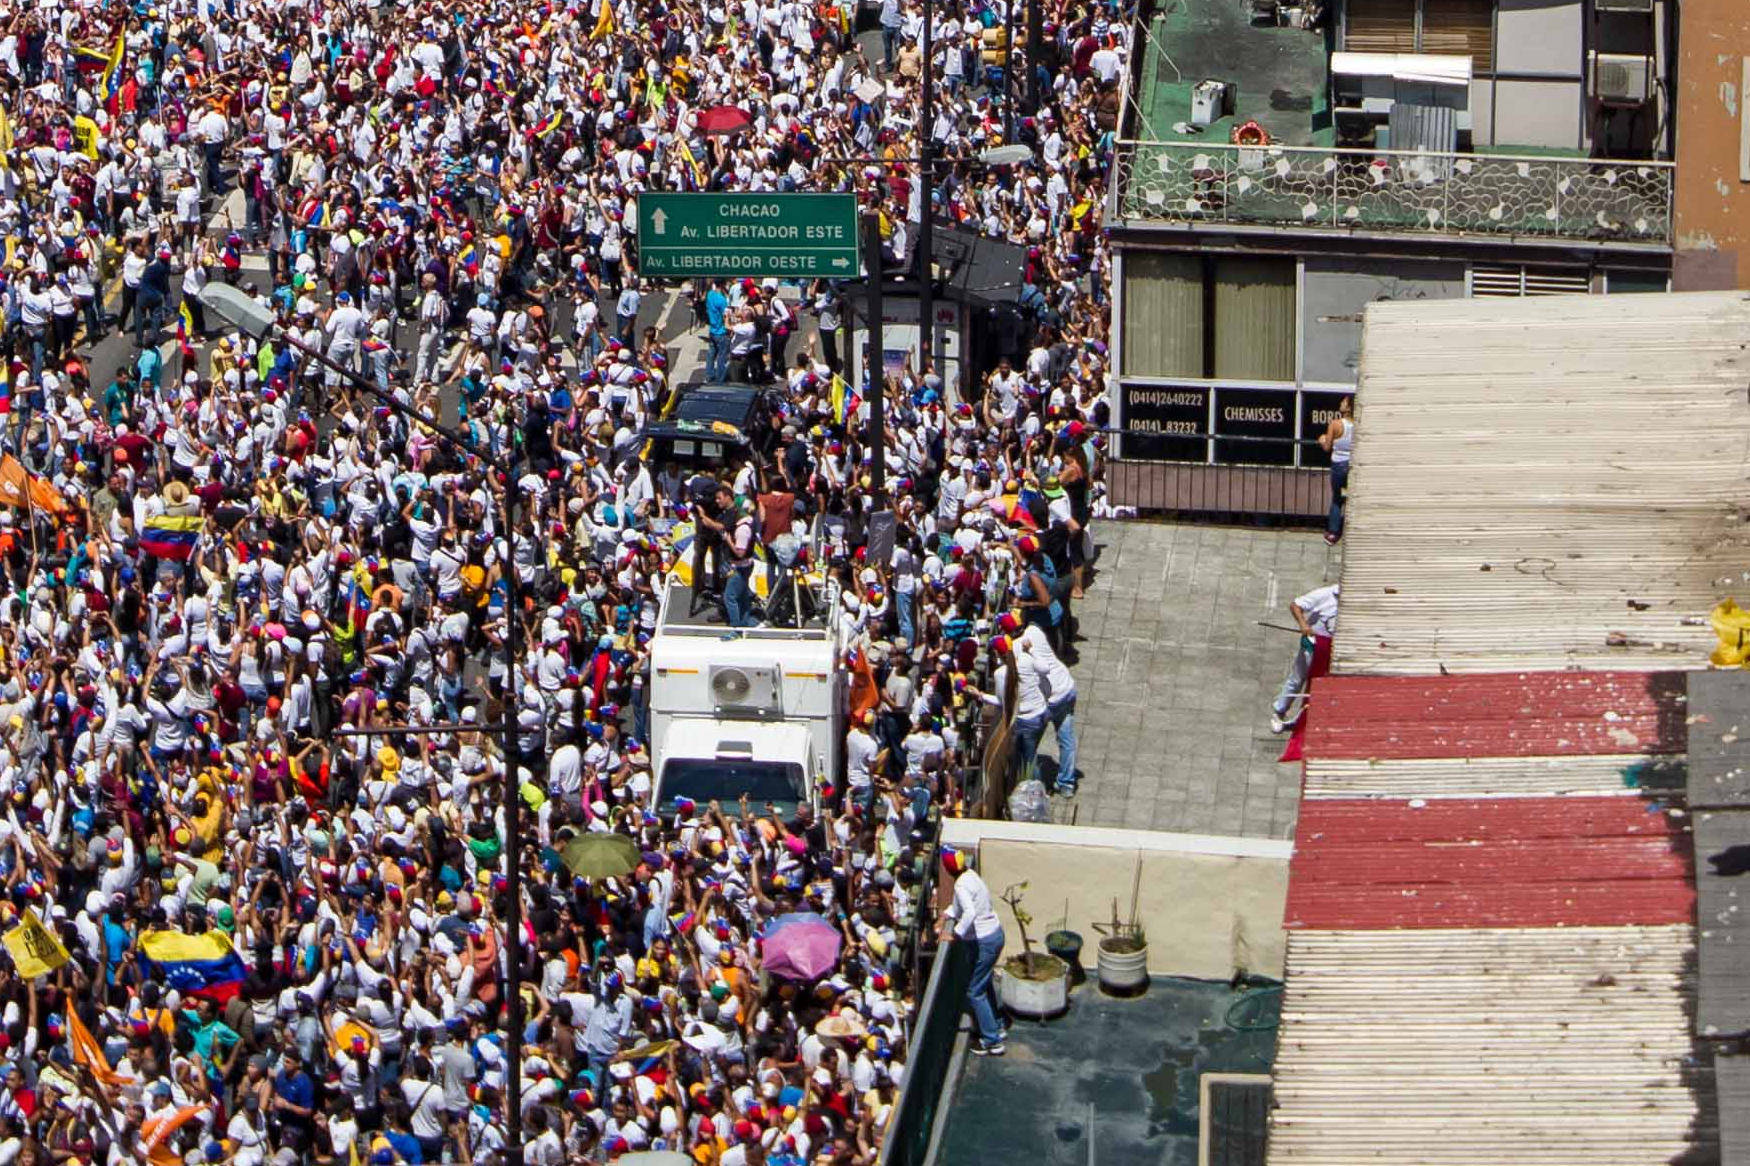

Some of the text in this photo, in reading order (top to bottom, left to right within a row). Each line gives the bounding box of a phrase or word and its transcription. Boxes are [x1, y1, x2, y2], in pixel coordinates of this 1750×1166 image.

[719, 204, 781, 217] CHACAO
[680, 225, 843, 239] Av. LIBERTADOR ESTE
[646, 256, 817, 269] Av. LIBERTADOR OESTE
[1129, 390, 1203, 407] (0414)2640222
[1224, 406, 1284, 423] CHEMISSES
